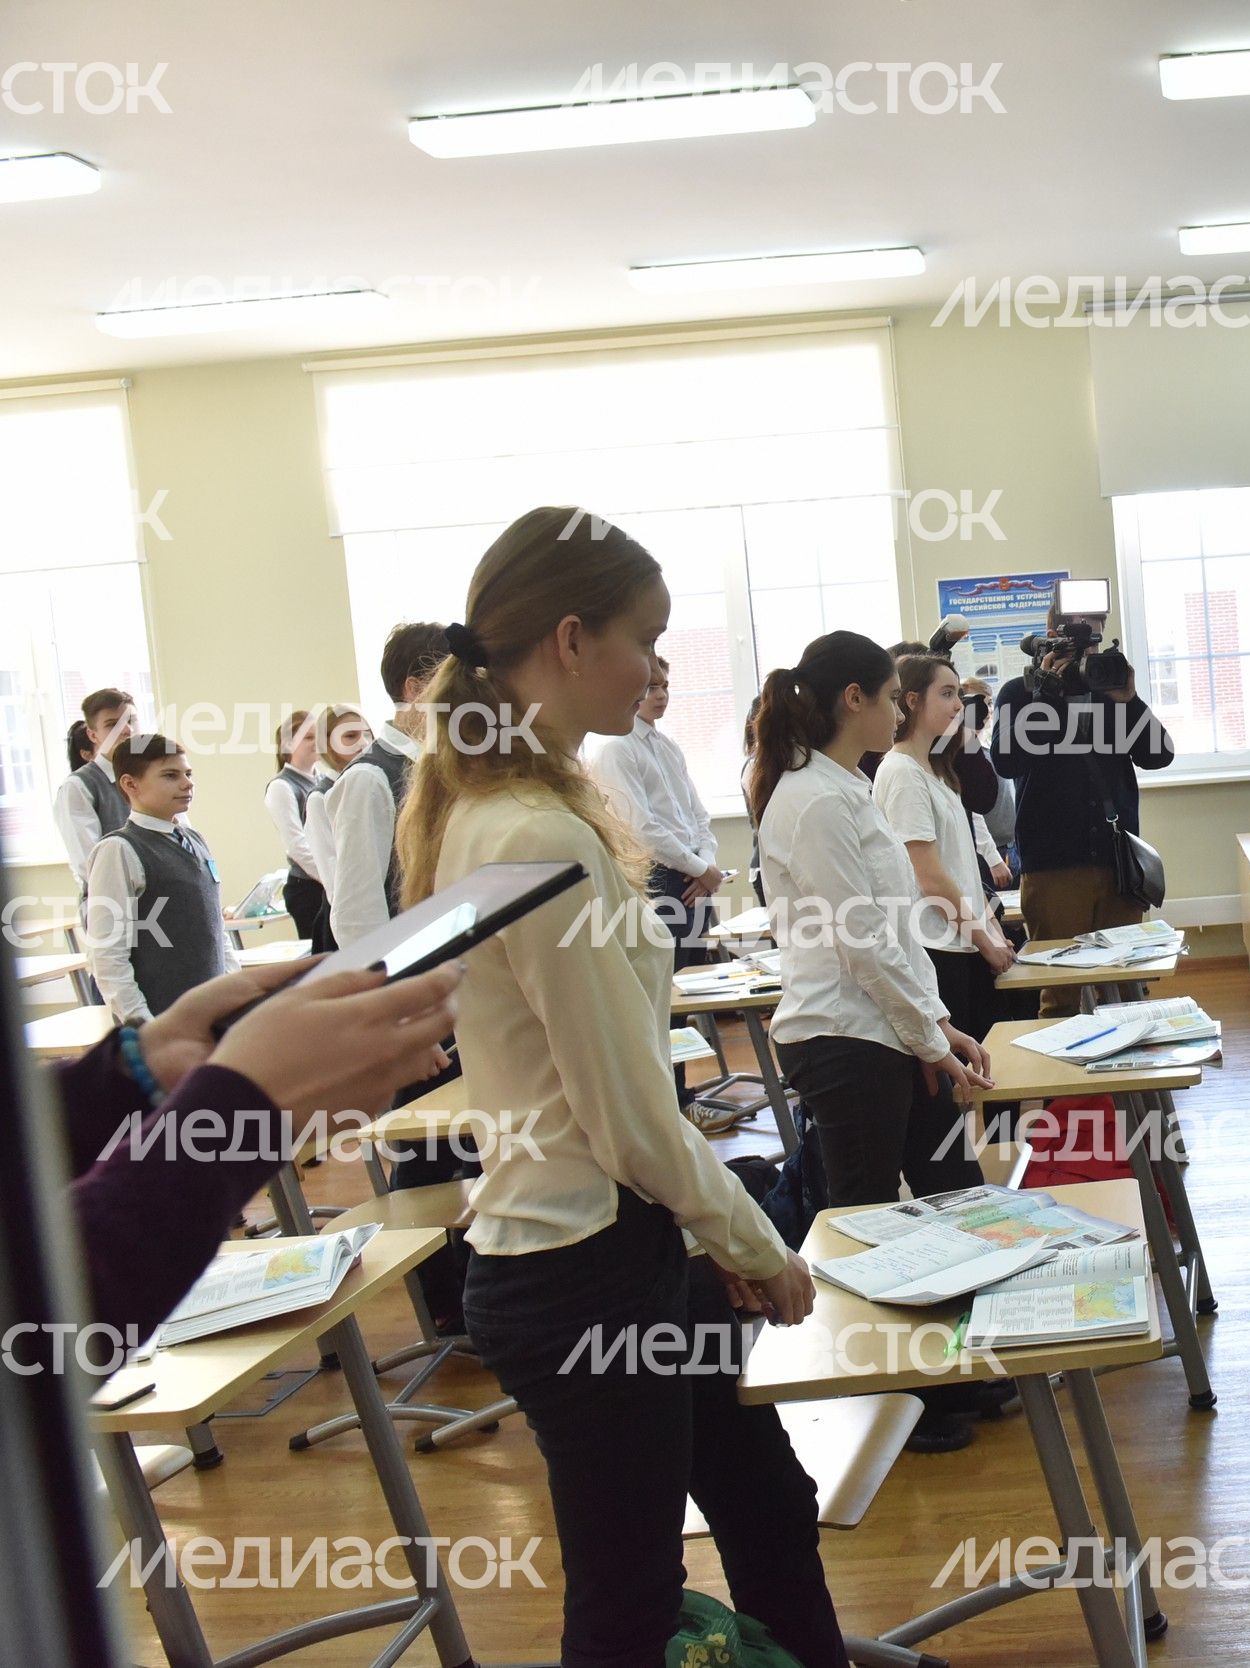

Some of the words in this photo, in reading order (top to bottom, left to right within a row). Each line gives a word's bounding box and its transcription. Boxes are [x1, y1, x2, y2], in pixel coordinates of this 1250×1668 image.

[949, 594, 1014, 605] ГОСУДАРСТВЕННОЕ
[960, 602, 1006, 612] РОССИЙСКОЙ
[1009, 600, 1051, 609] ФЕДЕРАЦИИ
